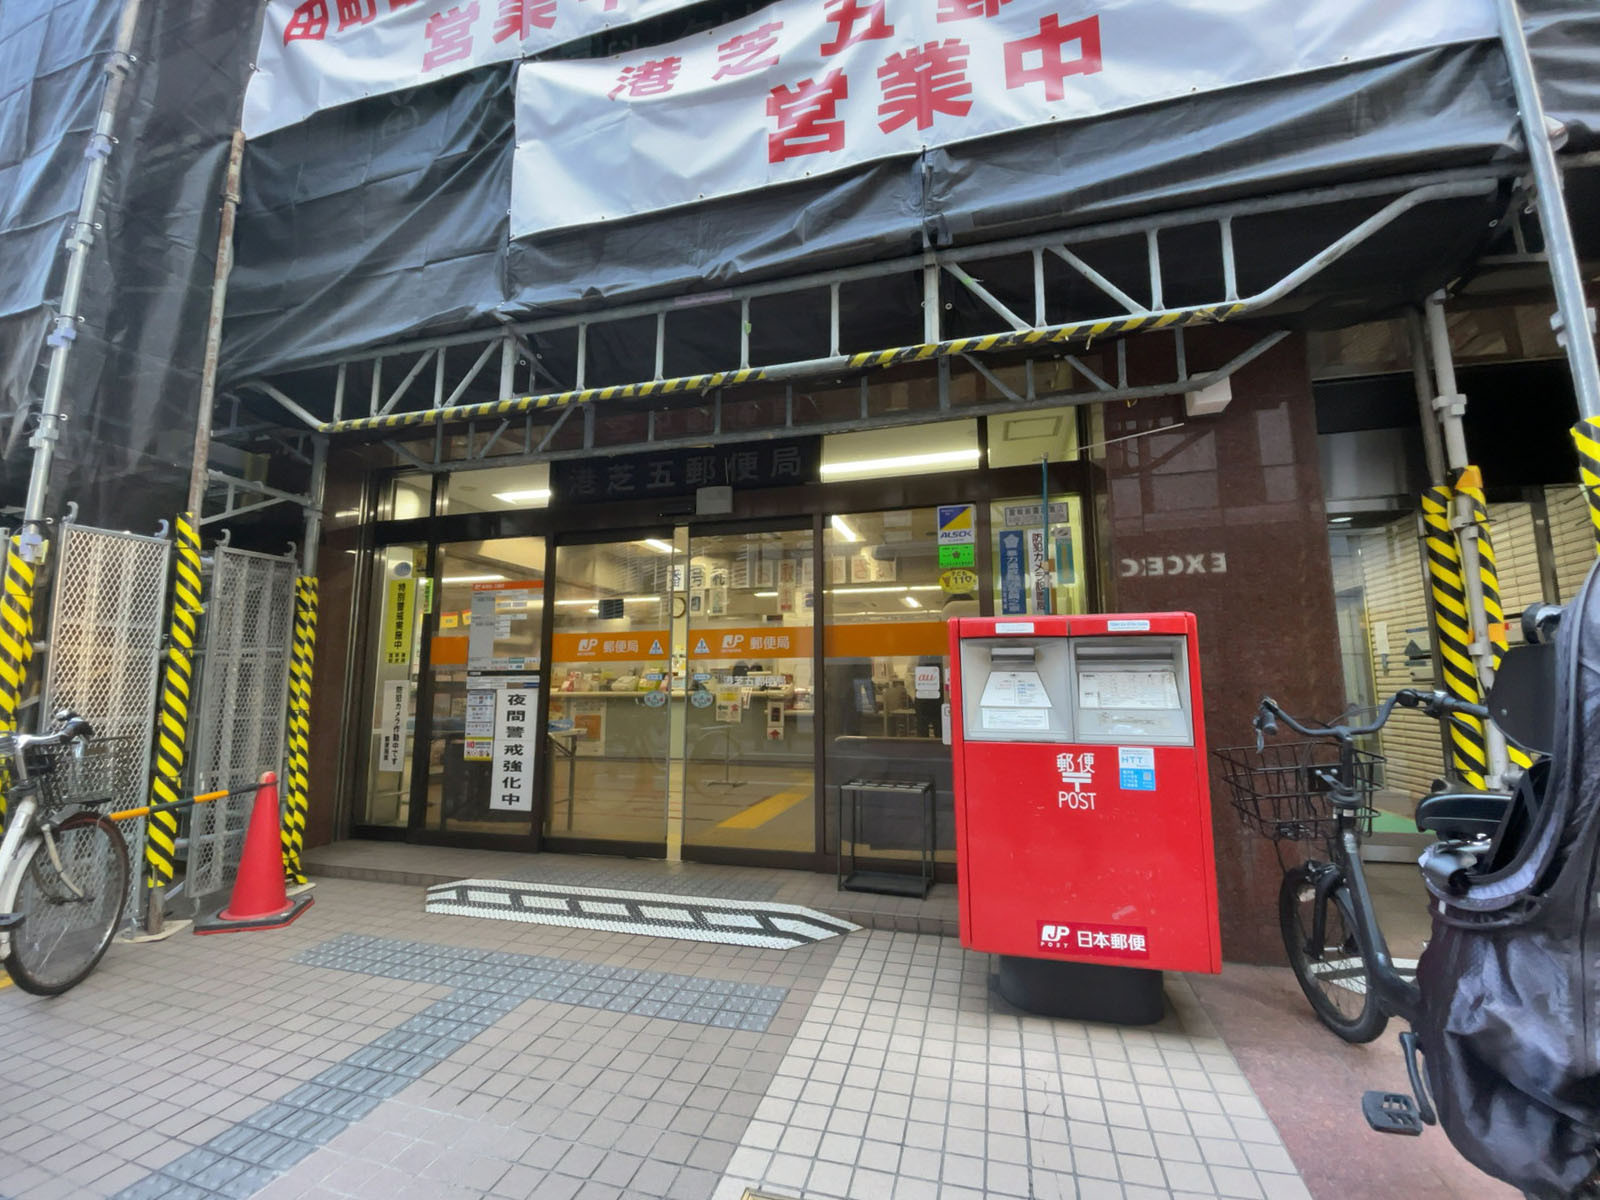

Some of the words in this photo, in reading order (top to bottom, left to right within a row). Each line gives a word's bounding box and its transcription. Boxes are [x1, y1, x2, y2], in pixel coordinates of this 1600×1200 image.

[283, 0, 418, 47] 田町
[421, 0, 618, 73] 営業
[766, 13, 1102, 163] 営業中
[569, 446, 802, 497] 港芝五郵便局
[941, 530, 972, 538] ALSOK
[603, 640, 638, 653] 郵便局
[751, 636, 789, 650] 郵便局
[918, 672, 936, 681] au
[1056, 752, 1095, 773] 郵便
[1058, 791, 1096, 810] POST
[1040, 941, 1069, 949] POST
[1042, 925, 1070, 942] JP
[1077, 930, 1147, 952] 日本郵便
